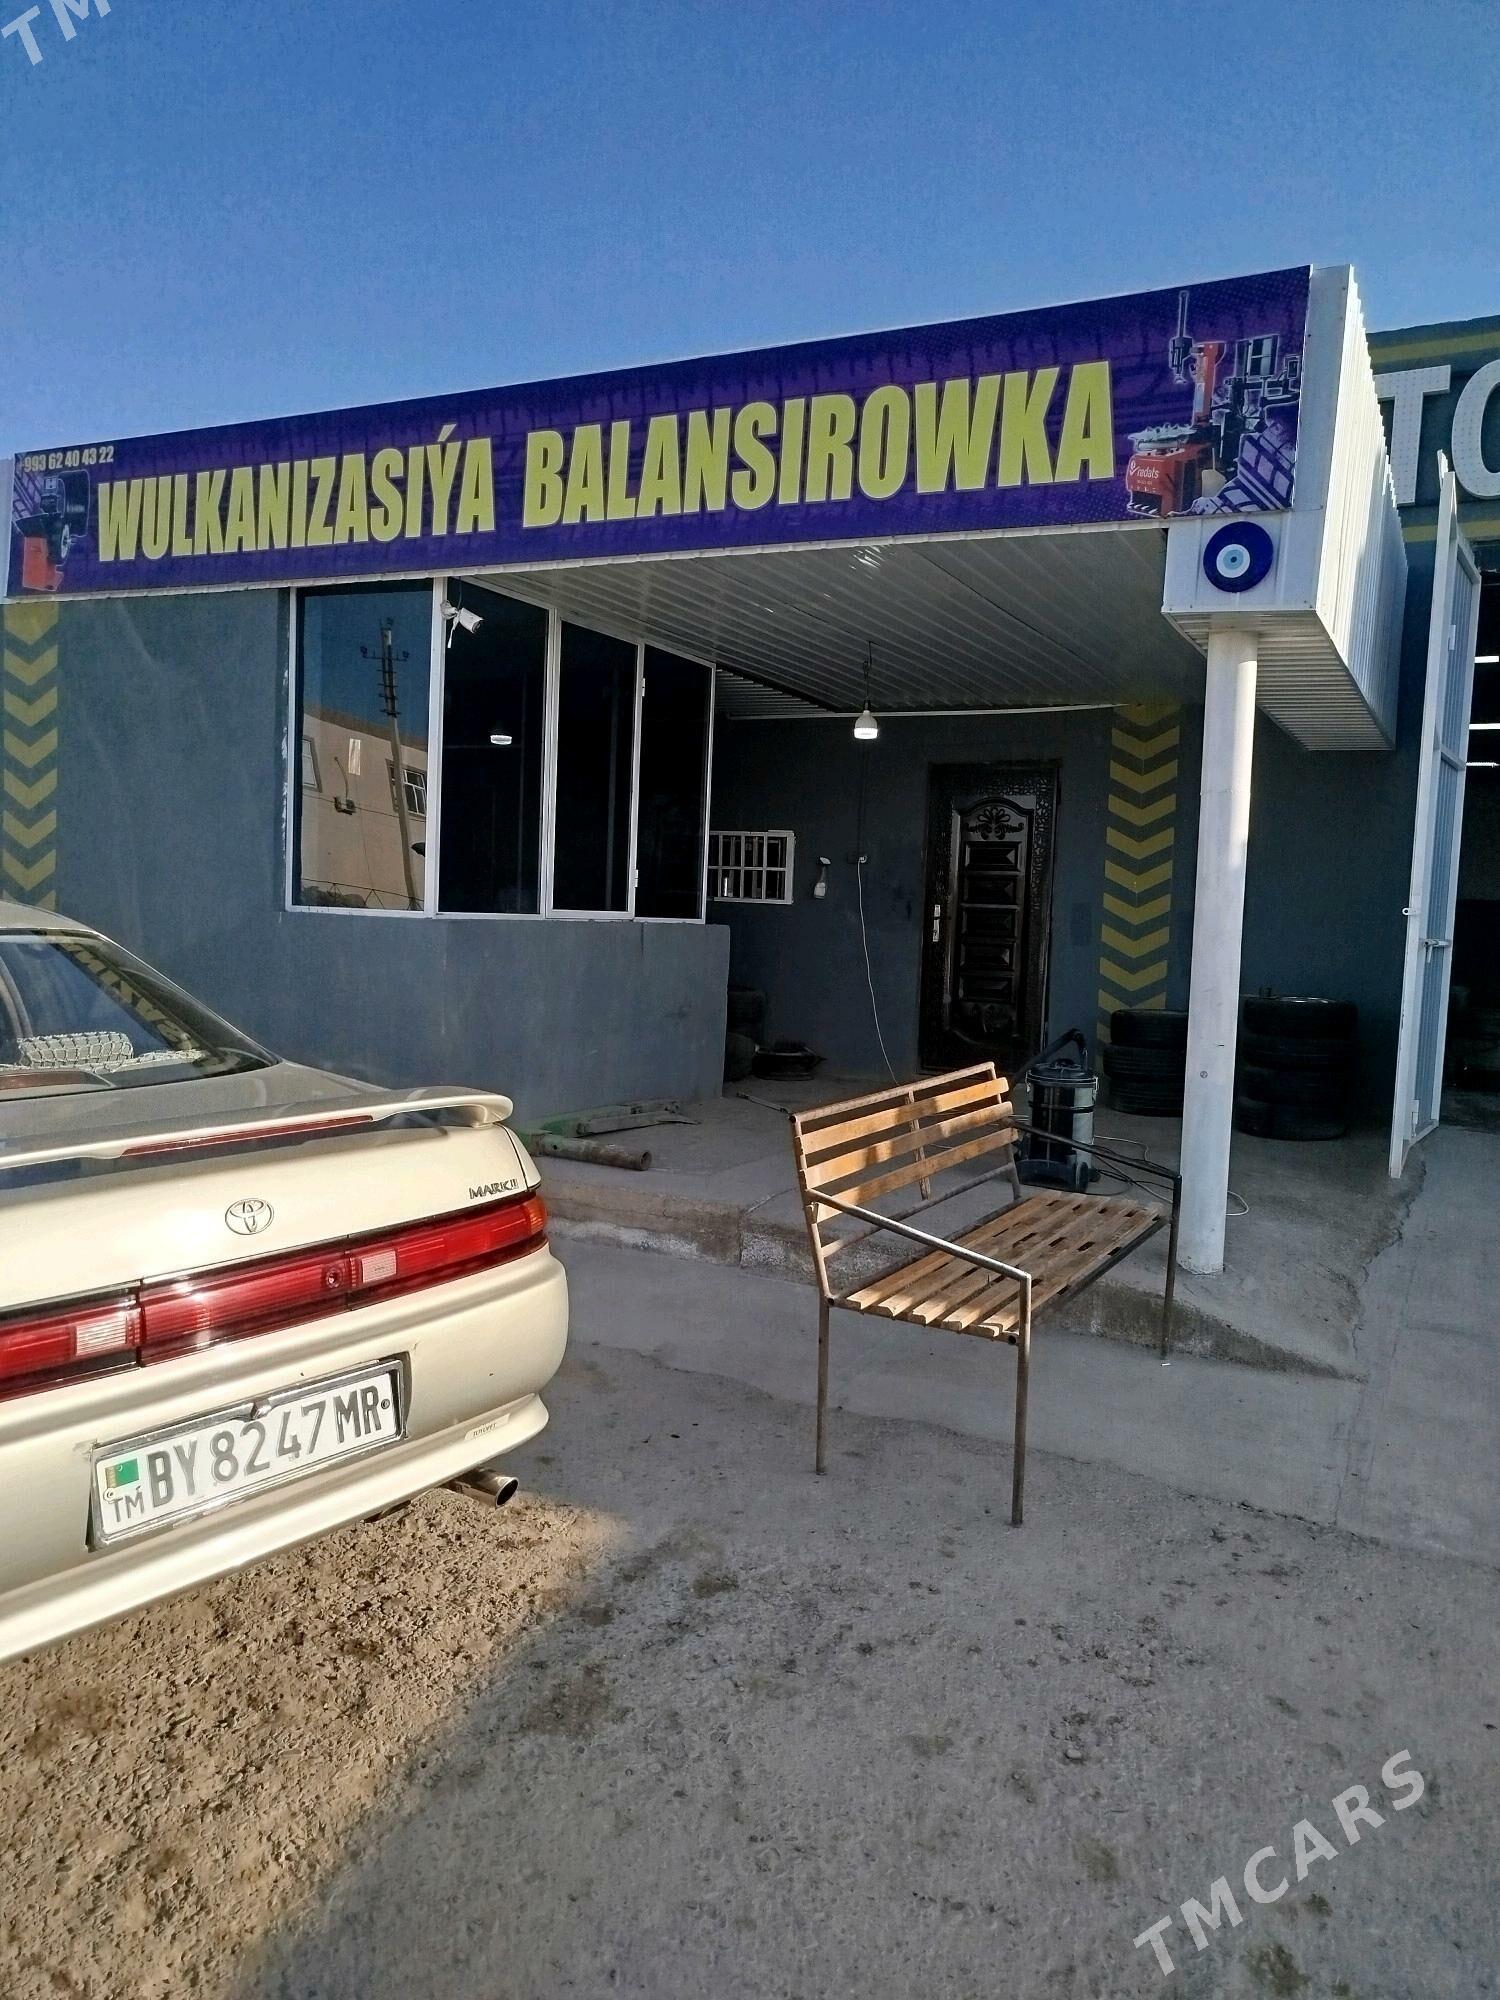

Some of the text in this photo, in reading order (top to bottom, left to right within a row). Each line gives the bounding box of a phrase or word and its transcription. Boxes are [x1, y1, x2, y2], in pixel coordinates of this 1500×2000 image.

[48, 452, 63, 470] 62
[64, 450, 80, 467] 40
[81, 447, 97, 465] 43
[98, 445, 115, 463] 22
[98, 360, 1116, 562] WULKANIZASIÝA BALANSIROWKA
[111, 1493, 145, 1523] TM
